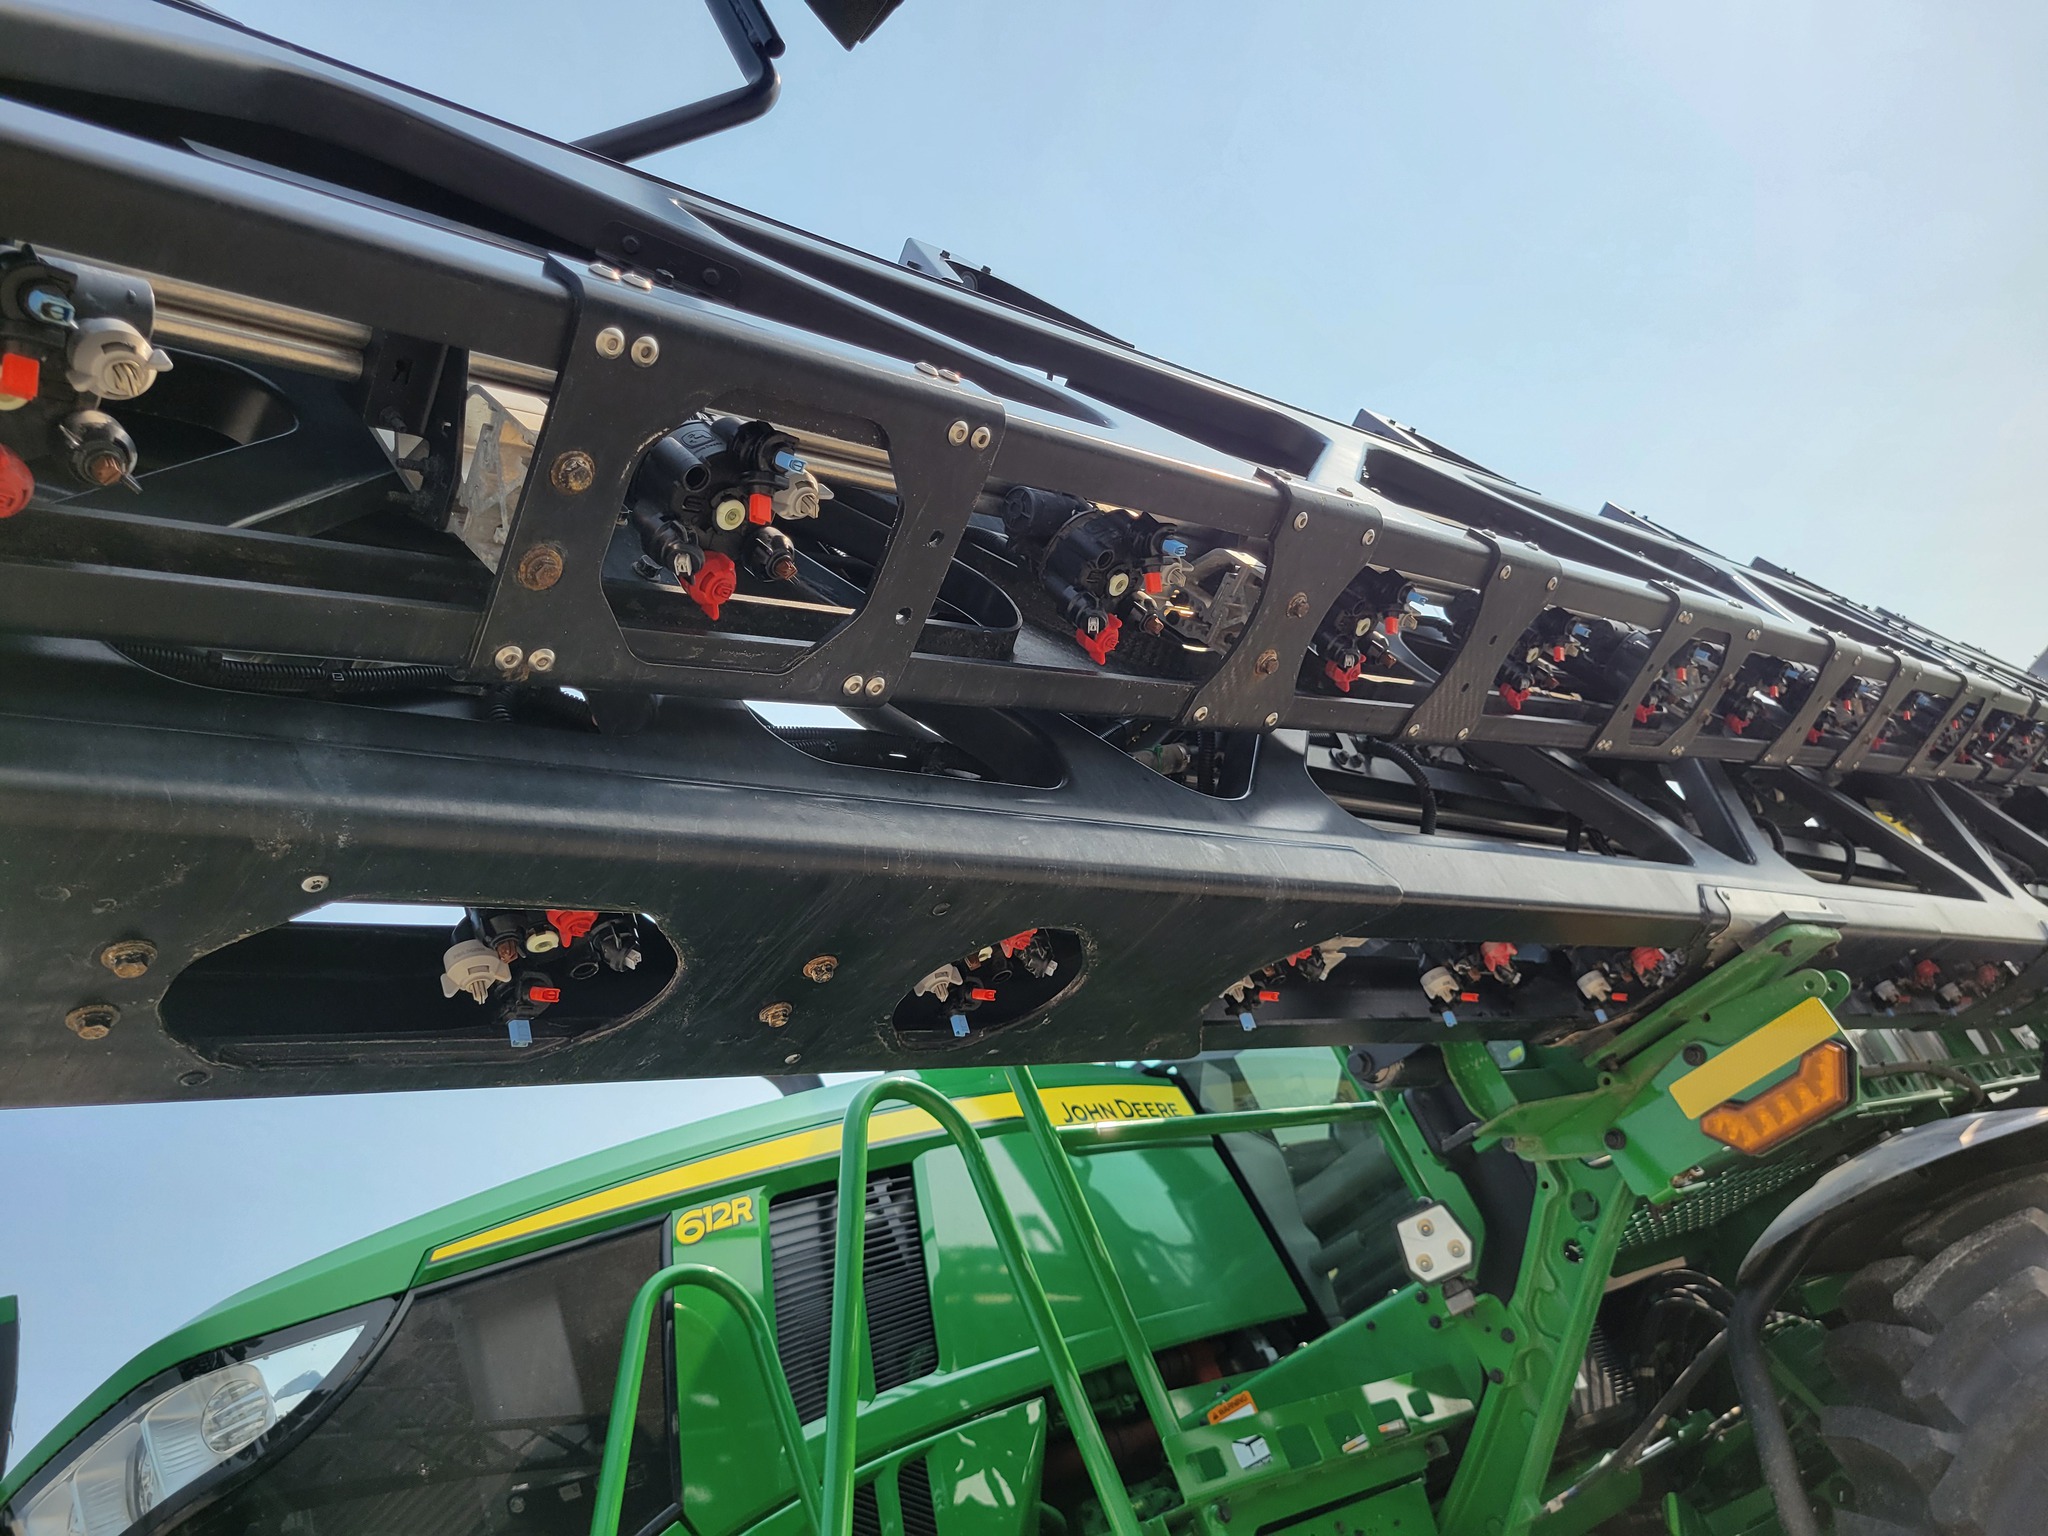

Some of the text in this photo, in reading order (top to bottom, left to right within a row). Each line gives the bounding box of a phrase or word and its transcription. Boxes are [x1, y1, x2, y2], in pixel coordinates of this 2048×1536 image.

[1061, 1098, 1178, 1123] JOHN DEERE
[675, 1195, 754, 1246] 612R
